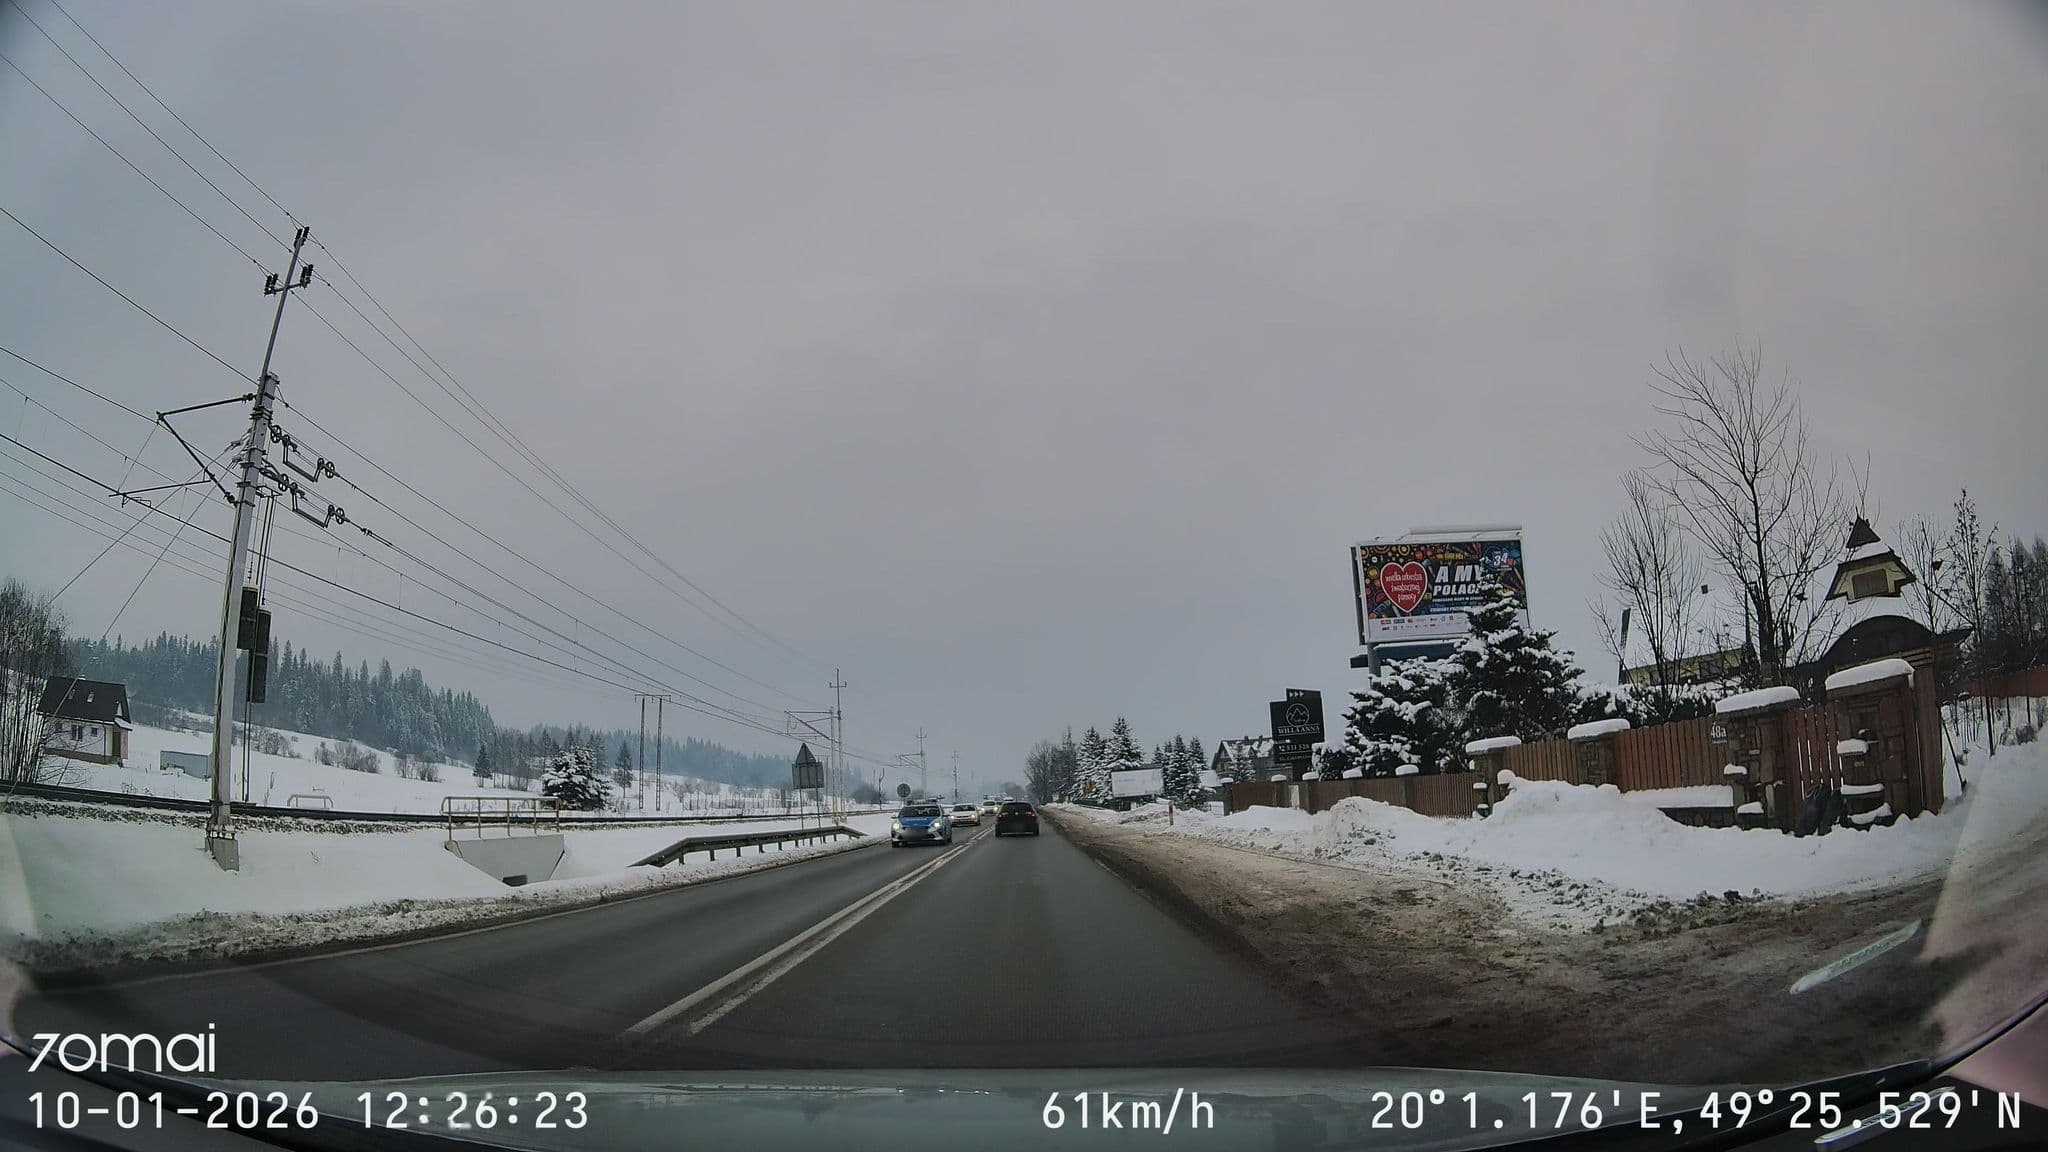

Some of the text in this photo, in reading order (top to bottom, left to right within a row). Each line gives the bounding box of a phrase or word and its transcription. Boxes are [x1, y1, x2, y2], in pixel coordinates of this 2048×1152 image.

[1494, 552, 1508, 566] 34
[1435, 566, 1449, 583] A
[1278, 725, 1320, 735] WILLA ANNA
[1711, 725, 1727, 738] 48a
